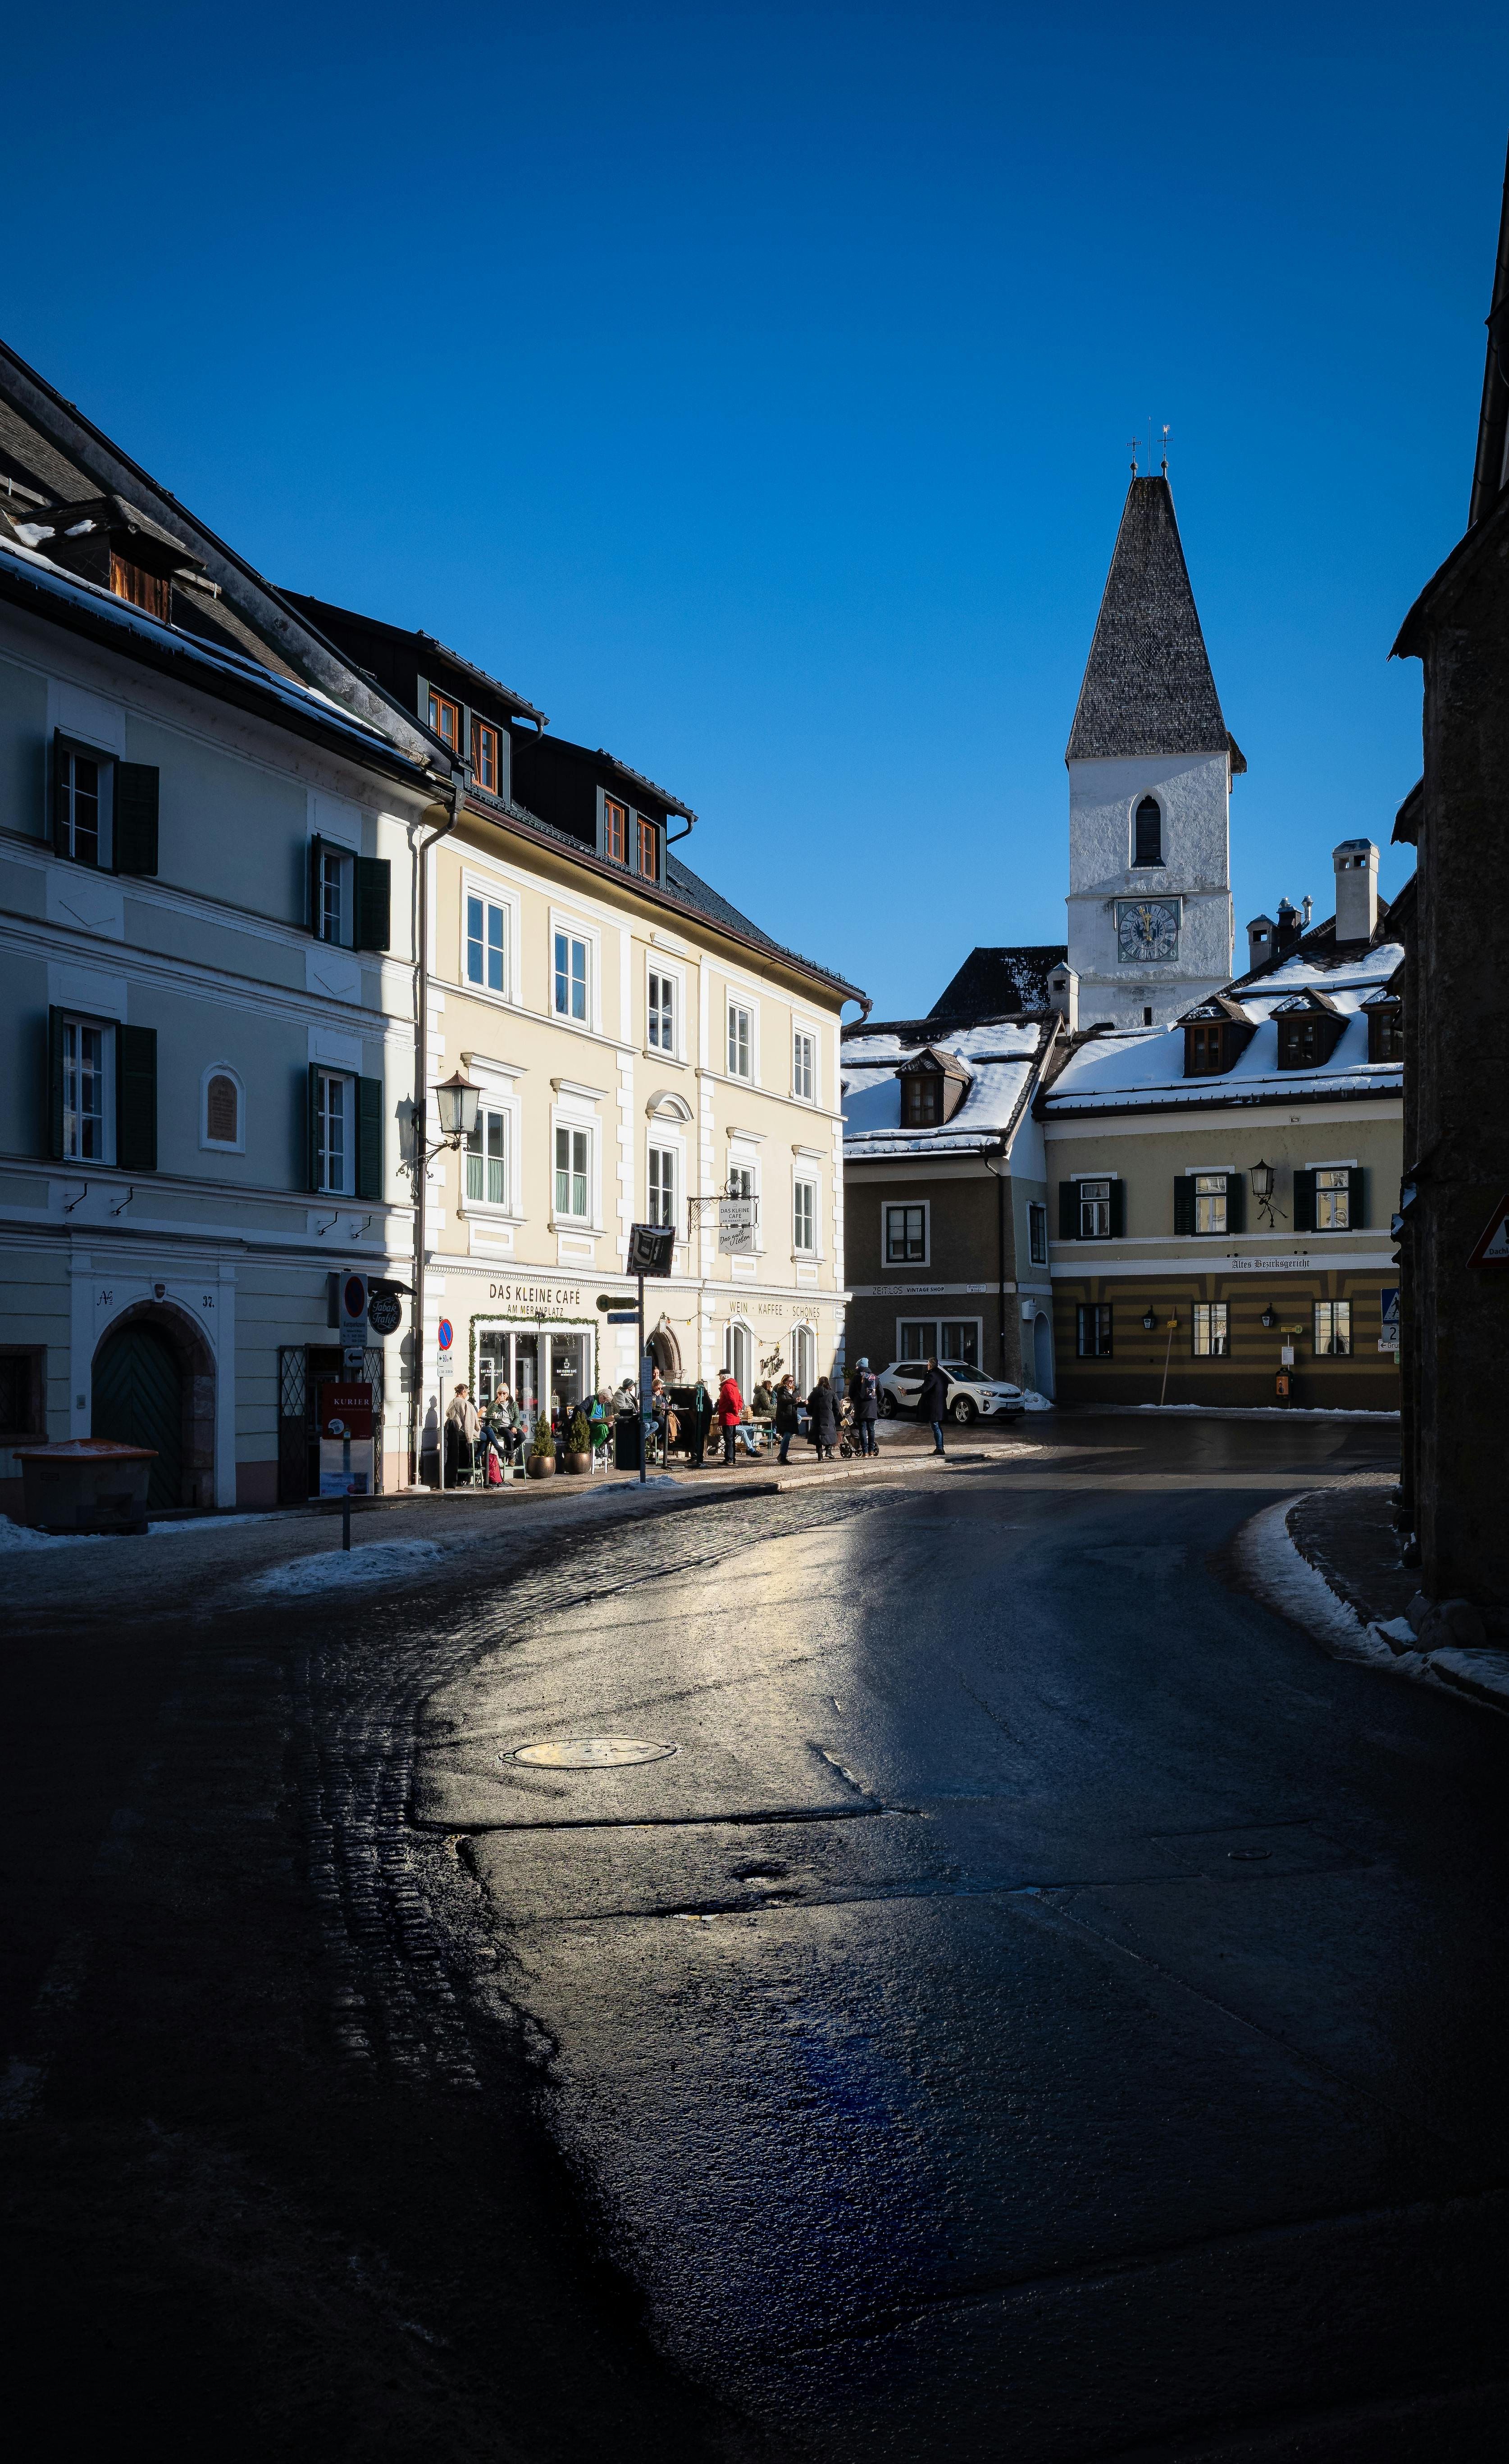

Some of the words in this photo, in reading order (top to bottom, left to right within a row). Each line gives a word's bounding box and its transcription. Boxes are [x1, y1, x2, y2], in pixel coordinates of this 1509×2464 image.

[720, 1236, 731, 1246] Das
[729, 1229, 745, 1246] gute
[1231, 1260, 1252, 1269] Altes
[1254, 1258, 1310, 1269] Bezirksgericht
[490, 1284, 511, 1300] DAS
[515, 1287, 552, 1303] KLEINE
[556, 1288, 580, 1305] CAFÉ
[373, 1301, 398, 1313] Tabak
[600, 1299, 608, 1308] H
[729, 1301, 748, 1314] WEIN
[758, 1303, 783, 1315] KAFFEE
[793, 1305, 820, 1318] SCHÖNES
[507, 1305, 517, 1314] AM
[520, 1305, 564, 1316] MERANPLATZ
[373, 1313, 399, 1324] Trafik
[1390, 1327, 1397, 1340] 2
